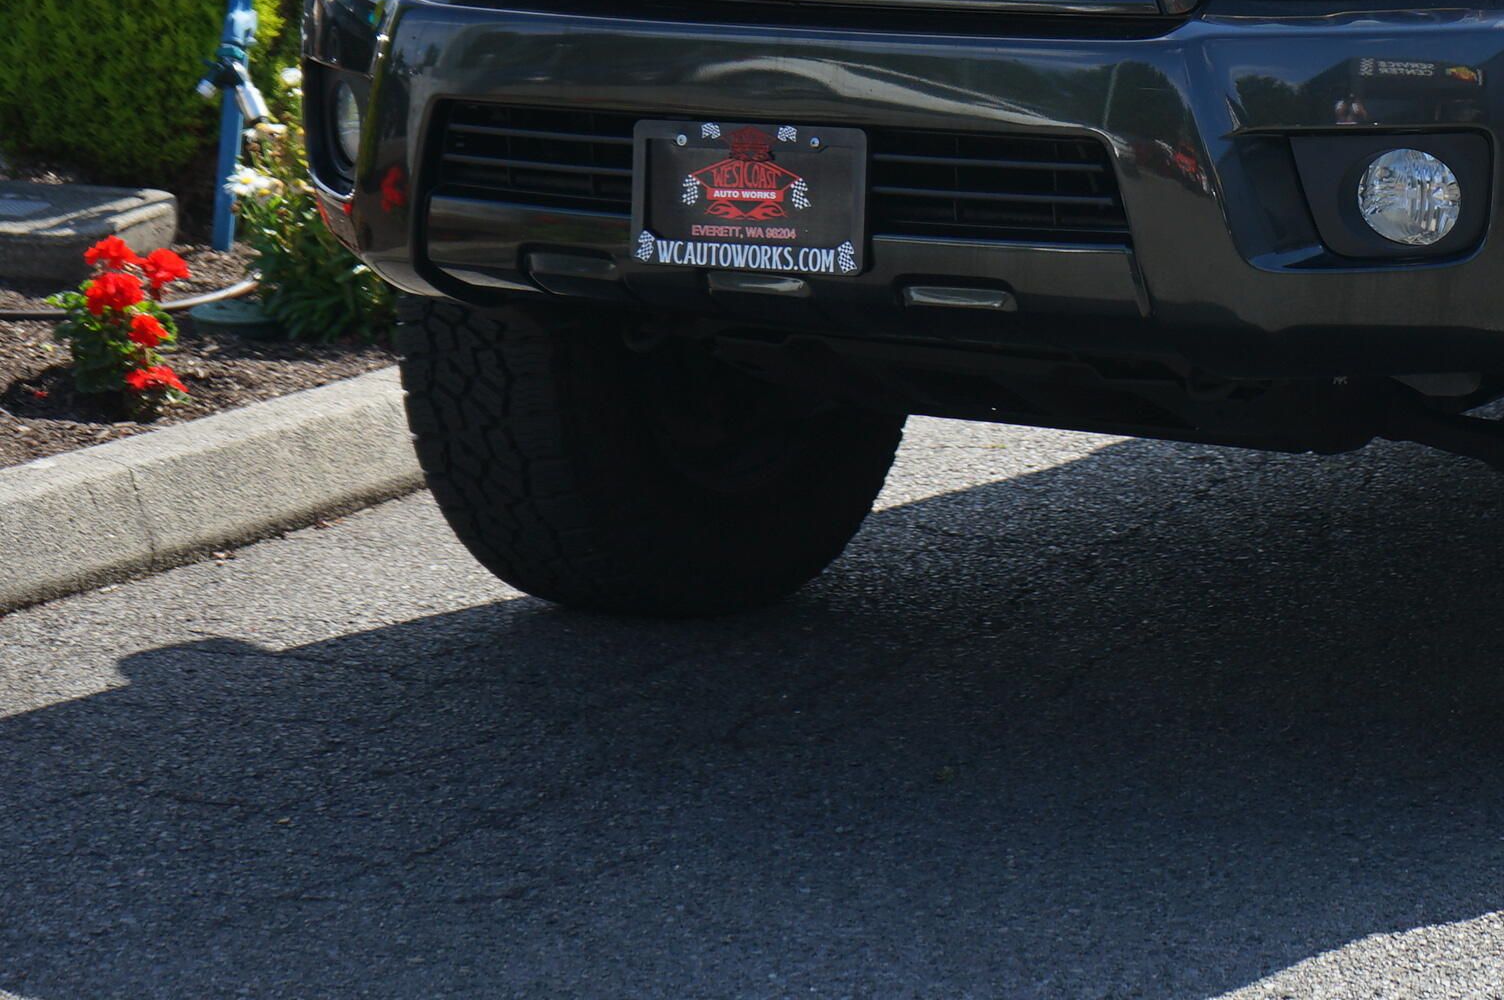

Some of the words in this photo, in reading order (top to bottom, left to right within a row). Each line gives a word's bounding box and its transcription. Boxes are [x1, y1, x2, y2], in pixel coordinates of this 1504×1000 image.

[713, 190, 740, 198] AUTO
[741, 190, 777, 199] WORKS
[691, 224, 744, 238] EVERETT,
[746, 226, 764, 238] WA
[656, 240, 835, 272] WCAUTOWORKS.COM
